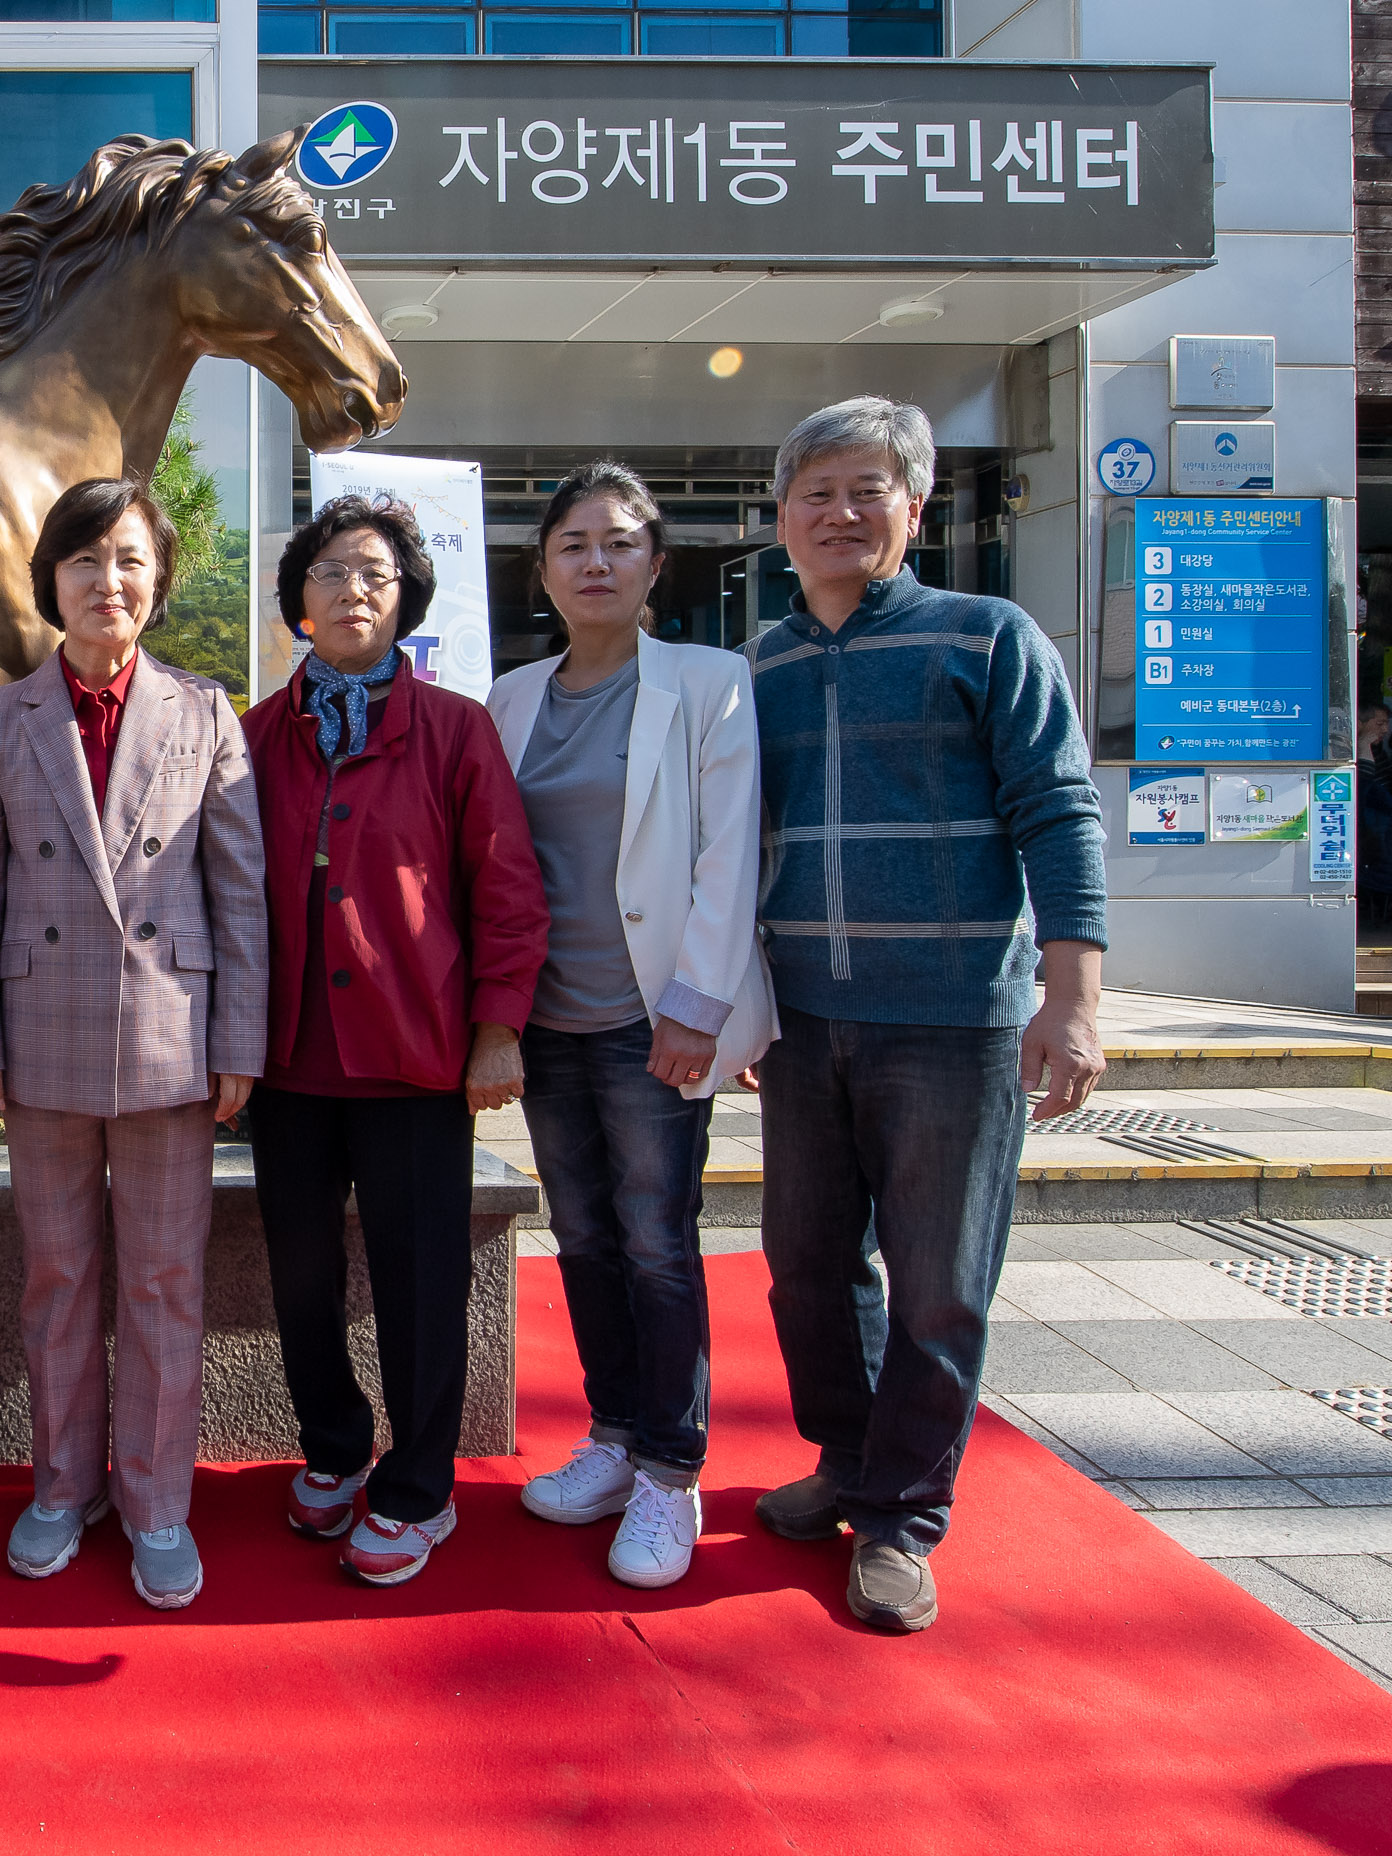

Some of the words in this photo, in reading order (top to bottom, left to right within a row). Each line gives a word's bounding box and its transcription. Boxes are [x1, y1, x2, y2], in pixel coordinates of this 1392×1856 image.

[439, 117, 797, 205] 자양제1동
[831, 119, 1140, 206] 주민센터
[1112, 461, 1140, 479] 37
[342, 485, 371, 496] 2019년
[1152, 510, 1216, 527] 자양제1동
[1220, 510, 1302, 527] 주민센터안내
[1161, 528, 1207, 536] Jayang1-dong
[1208, 528, 1244, 536] Community
[431, 532, 463, 552] 축제
[1152, 552, 1165, 570] 3
[1180, 554, 1213, 567] 대강당
[1180, 583, 1217, 597] 동장실,
[1153, 588, 1165, 607] 2
[1180, 598, 1228, 612] 소강의실,
[1233, 598, 1266, 611] 회의실
[1153, 625, 1162, 643] 1
[1180, 627, 1213, 641] 민원실
[1150, 662, 1169, 679] B1
[1181, 663, 1215, 677] 주차장
[1180, 700, 1214, 713] 예비군
[1216, 700, 1287, 713] 동대본부(2층)
[1203, 739, 1226, 748] 꿈꾸는
[1136, 793, 1200, 805] 자원봉사캠프
[1216, 815, 1241, 823] 자양1동
[1242, 815, 1265, 823] 새마을
[1318, 803, 1347, 837] 무더위
[1319, 840, 1346, 862] 쉼터
